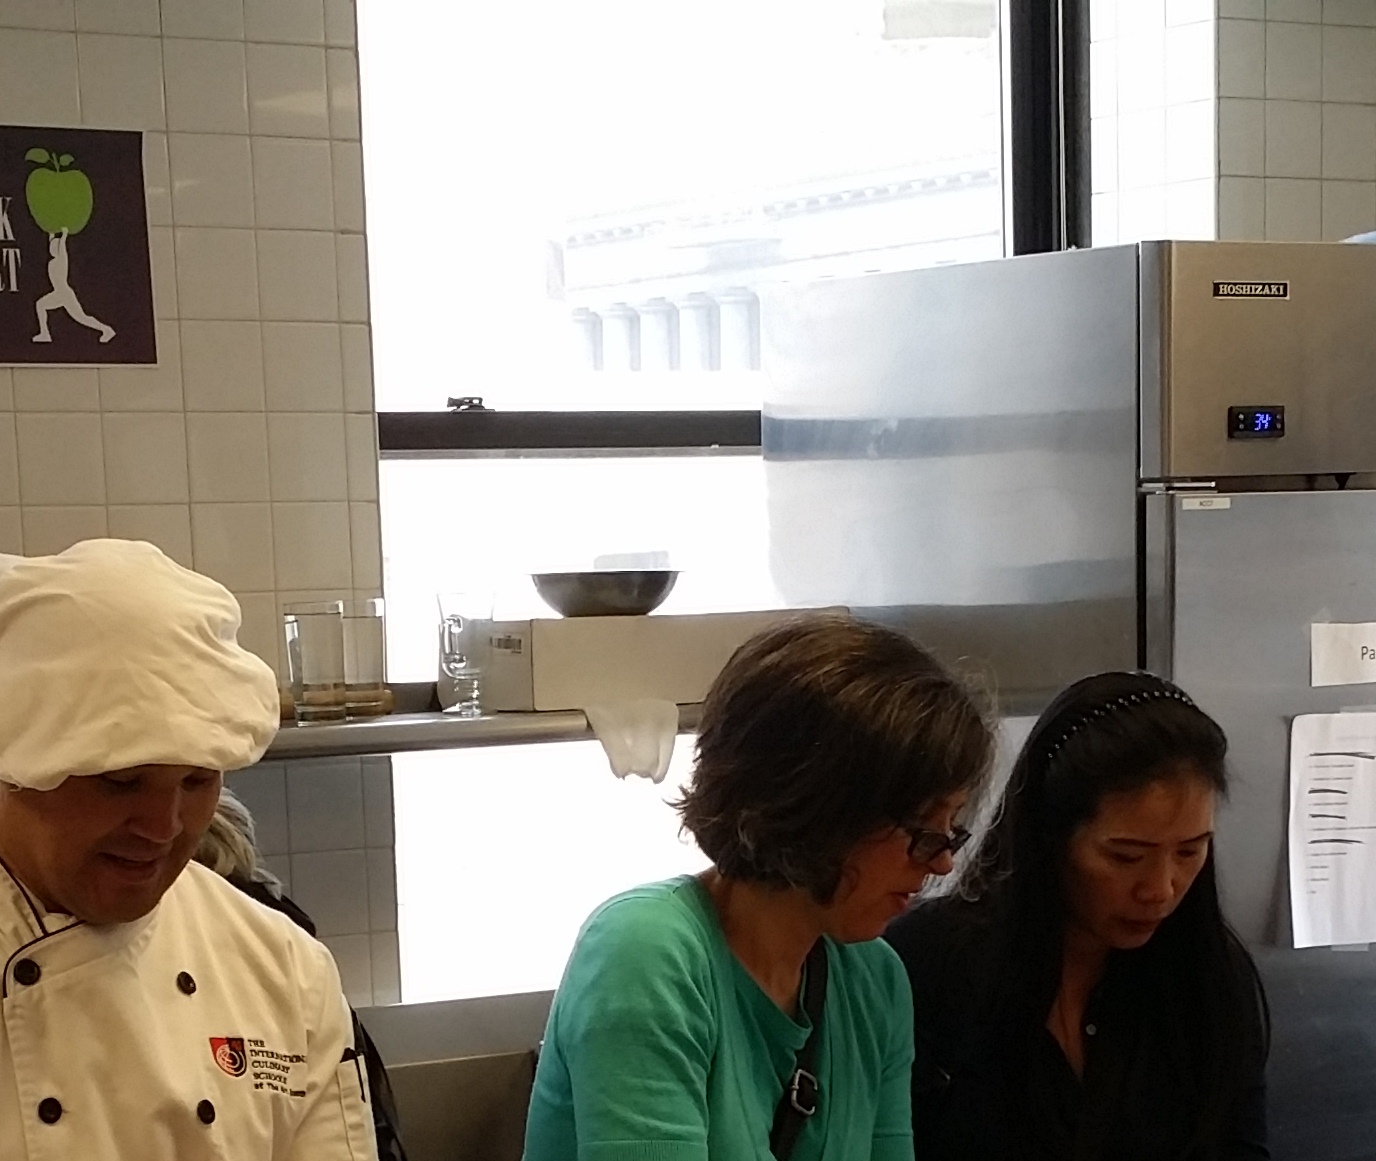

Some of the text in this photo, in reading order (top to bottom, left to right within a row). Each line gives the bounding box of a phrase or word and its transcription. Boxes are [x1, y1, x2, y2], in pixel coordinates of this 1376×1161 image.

[1219, 284, 1285, 295] HOSHIZAKI
[247, 1039, 265, 1048] THE
[251, 1060, 290, 1073] CULINARY
